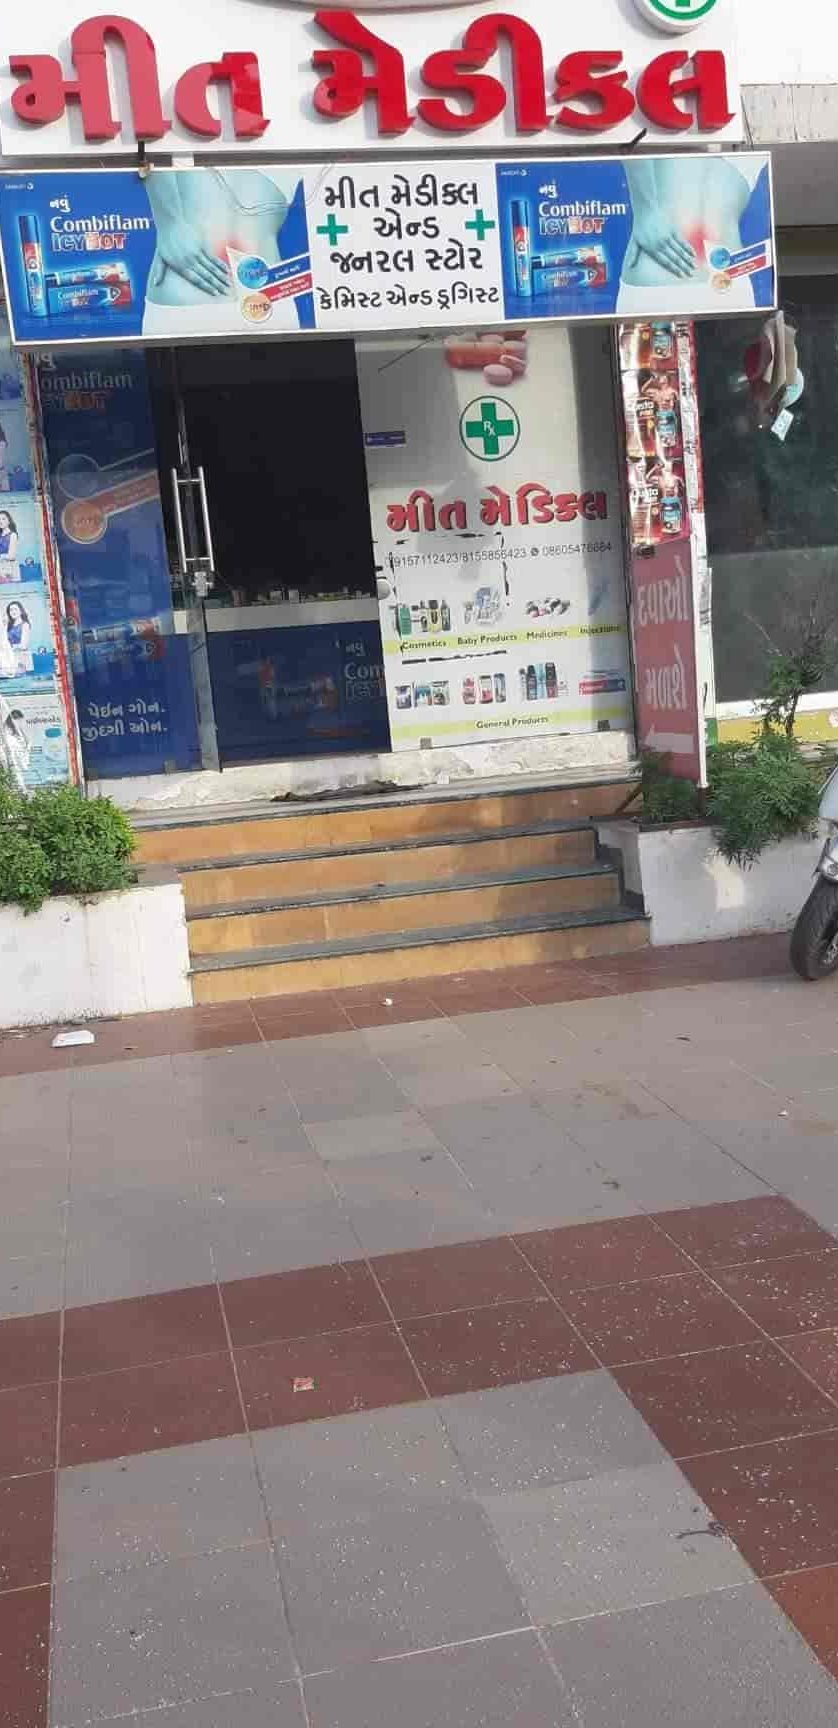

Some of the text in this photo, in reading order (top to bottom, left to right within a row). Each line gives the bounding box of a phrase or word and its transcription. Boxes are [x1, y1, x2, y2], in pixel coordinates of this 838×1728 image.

[8, 8, 735, 141] મીત મેડીકલ
[324, 174, 478, 208] મીત મેડીકલ
[49, 194, 71, 213] નવું
[539, 201, 626, 217] Combiflam
[50, 216, 150, 233] Combiflam
[373, 208, 440, 240] એન્ડ
[330, 247, 414, 275] જનરલ
[425, 238, 483, 272] સ્ટોર
[316, 286, 383, 310] કેમિસ્ટ
[386, 284, 433, 306] એન્ડ
[437, 281, 500, 310] ડ્રગિસ્ટ
[40, 371, 132, 390] ombiflam
[386, 482, 609, 532] મીત મેડિકલ
[458, 632, 517, 647] Baby Products
[527, 628, 567, 640] Medicines
[402, 639, 446, 650] Cosmetics
[476, 715, 549, 730] General Products
